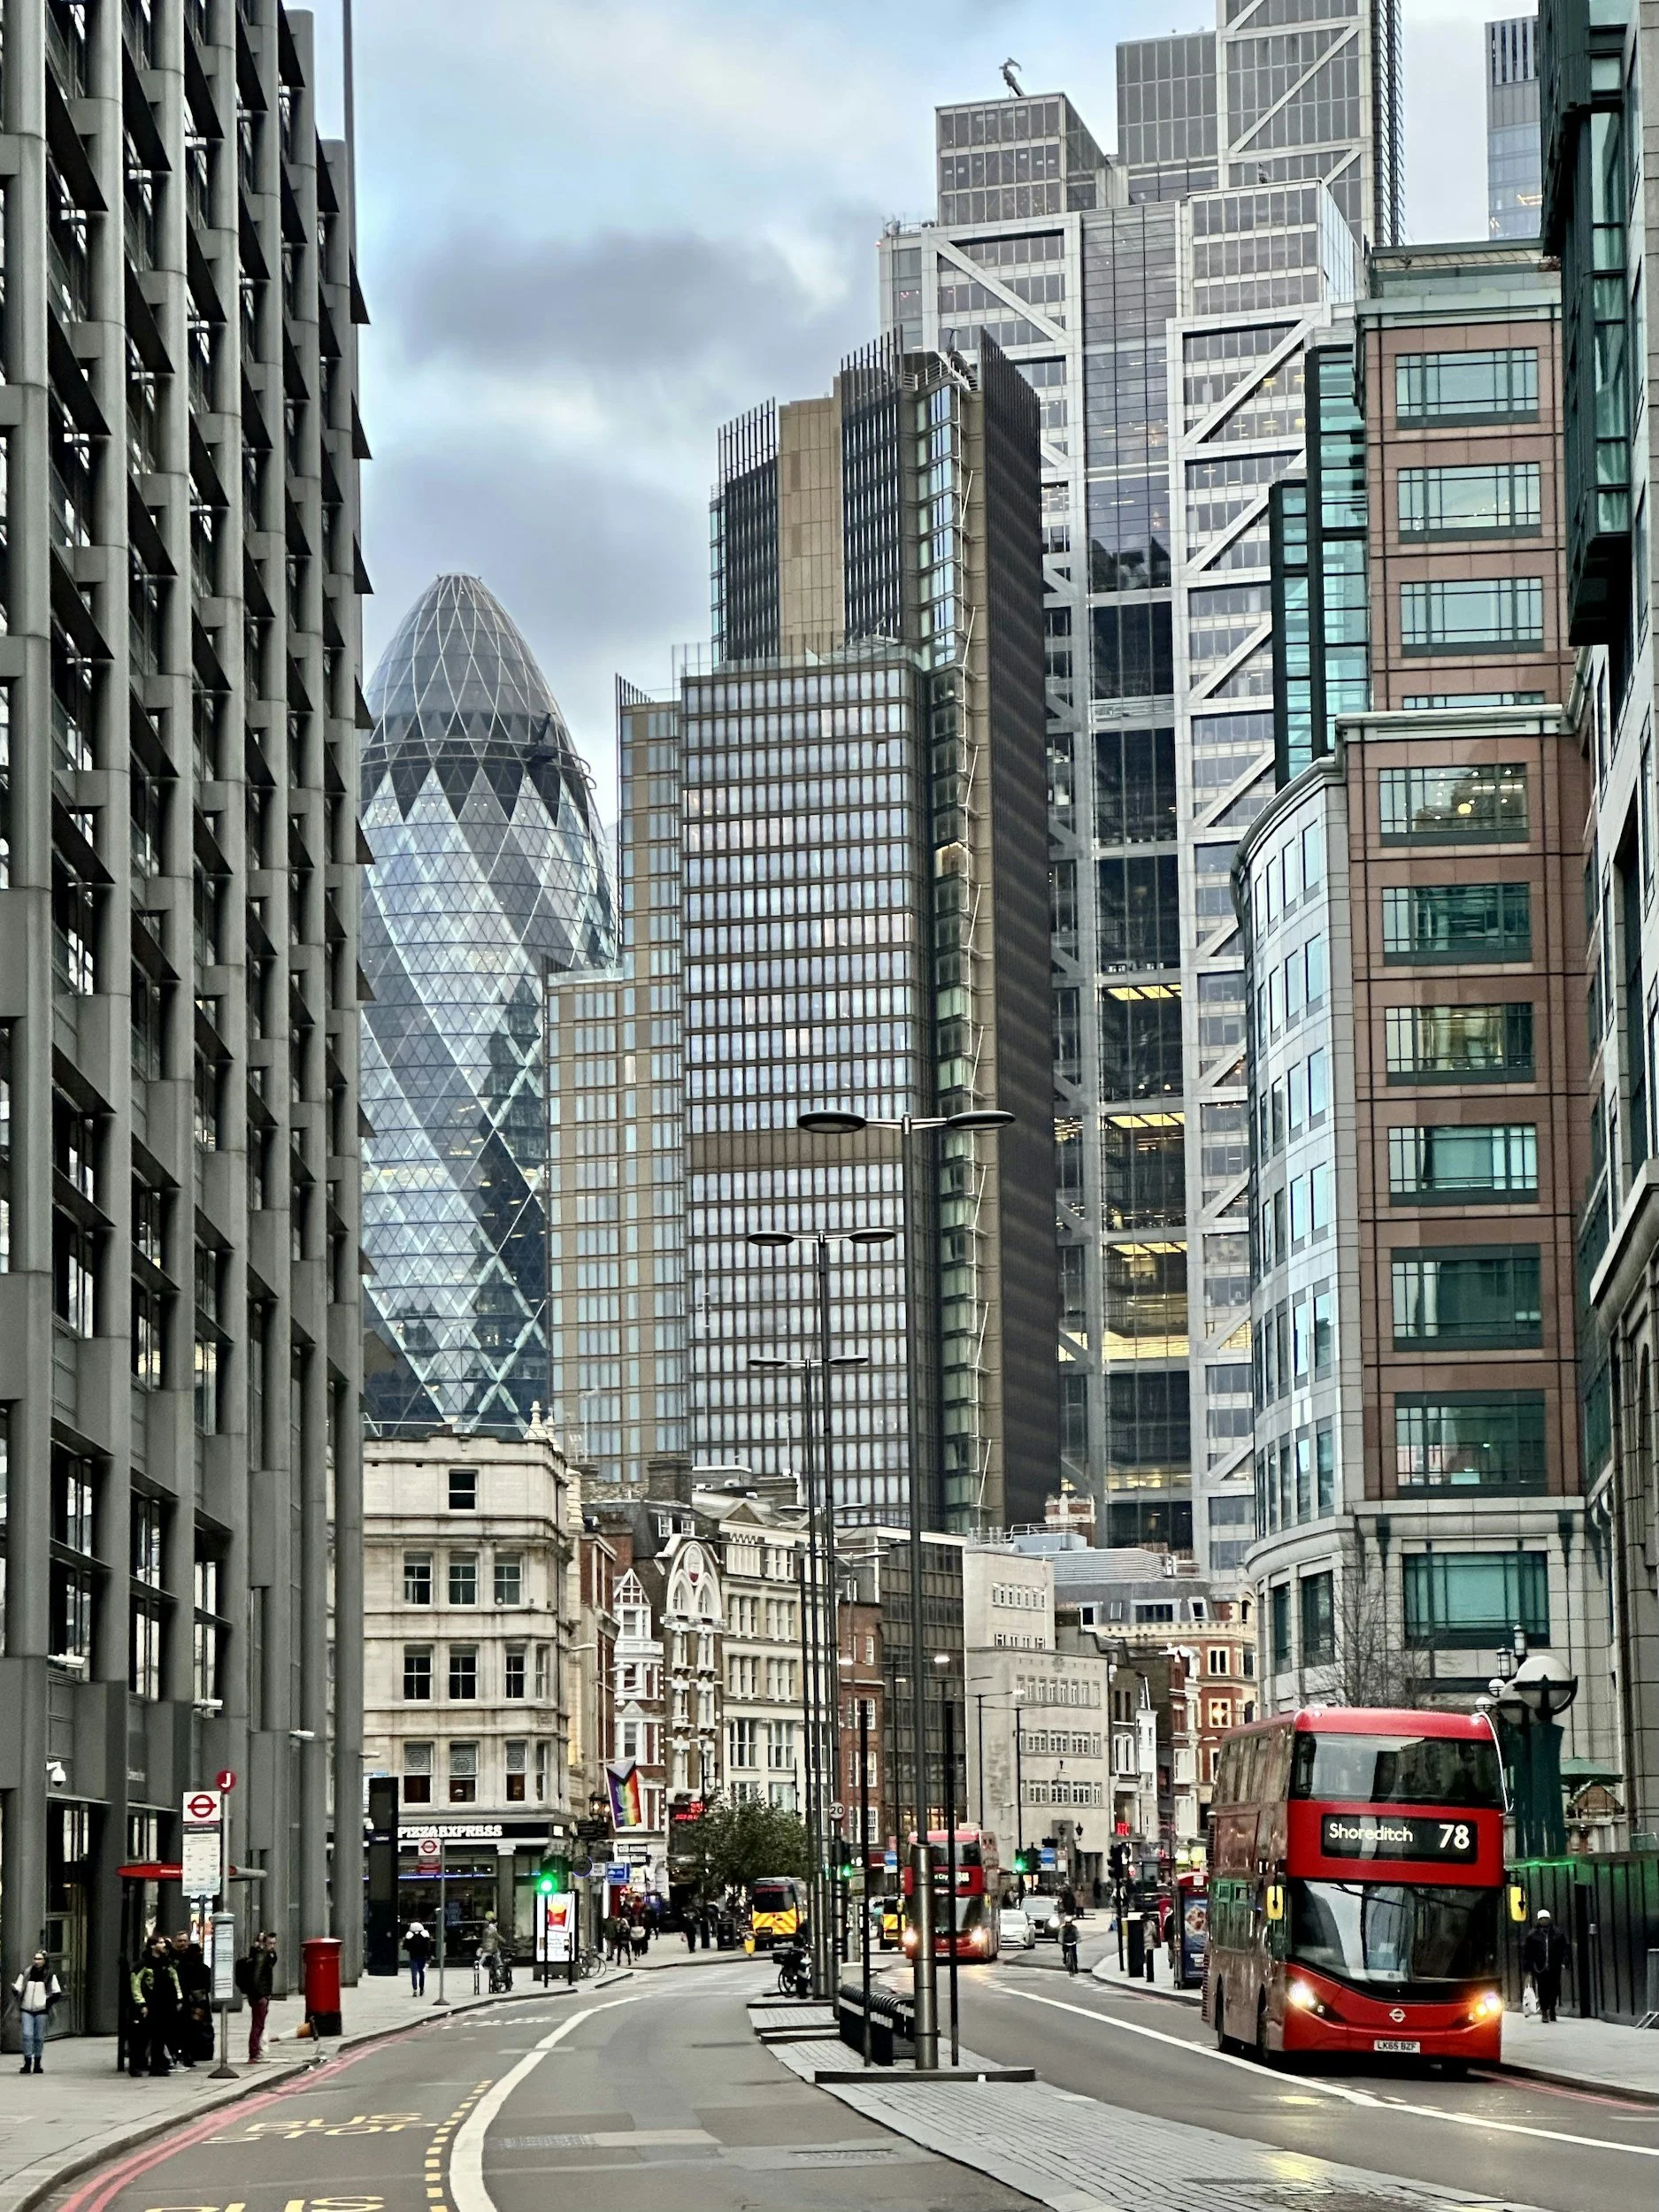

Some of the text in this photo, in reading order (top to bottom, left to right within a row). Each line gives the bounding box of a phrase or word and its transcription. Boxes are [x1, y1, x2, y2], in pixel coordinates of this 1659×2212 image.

[221, 1772, 231, 1788] J
[831, 1806, 844, 1815] 20
[1117, 1823, 1130, 1836] KFC
[1329, 1823, 1471, 1849] Shoreditch 78
[244, 2113, 423, 2132] BUS
[202, 2124, 440, 2144] STOP
[143, 2196, 385, 2212] US
